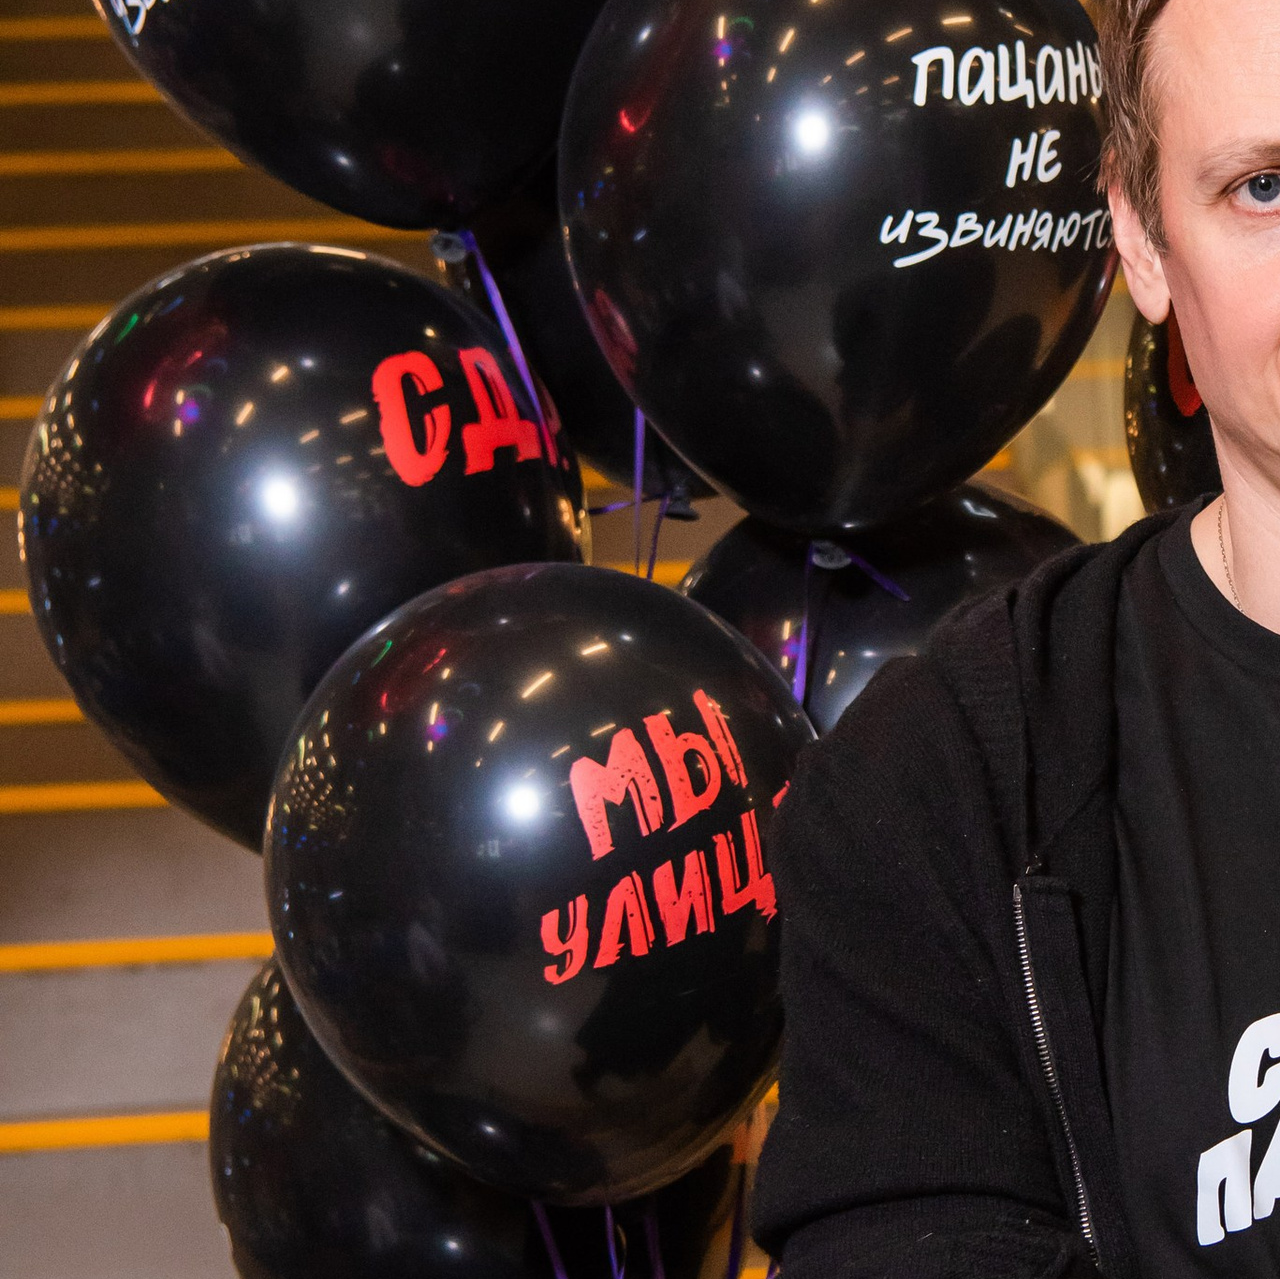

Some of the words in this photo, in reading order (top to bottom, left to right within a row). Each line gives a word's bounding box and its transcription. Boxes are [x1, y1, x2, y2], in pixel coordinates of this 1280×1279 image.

[1004, 129, 1063, 188] НЕ
[570, 688, 748, 861] МЫ
[540, 780, 791, 985] УЛИЦ
